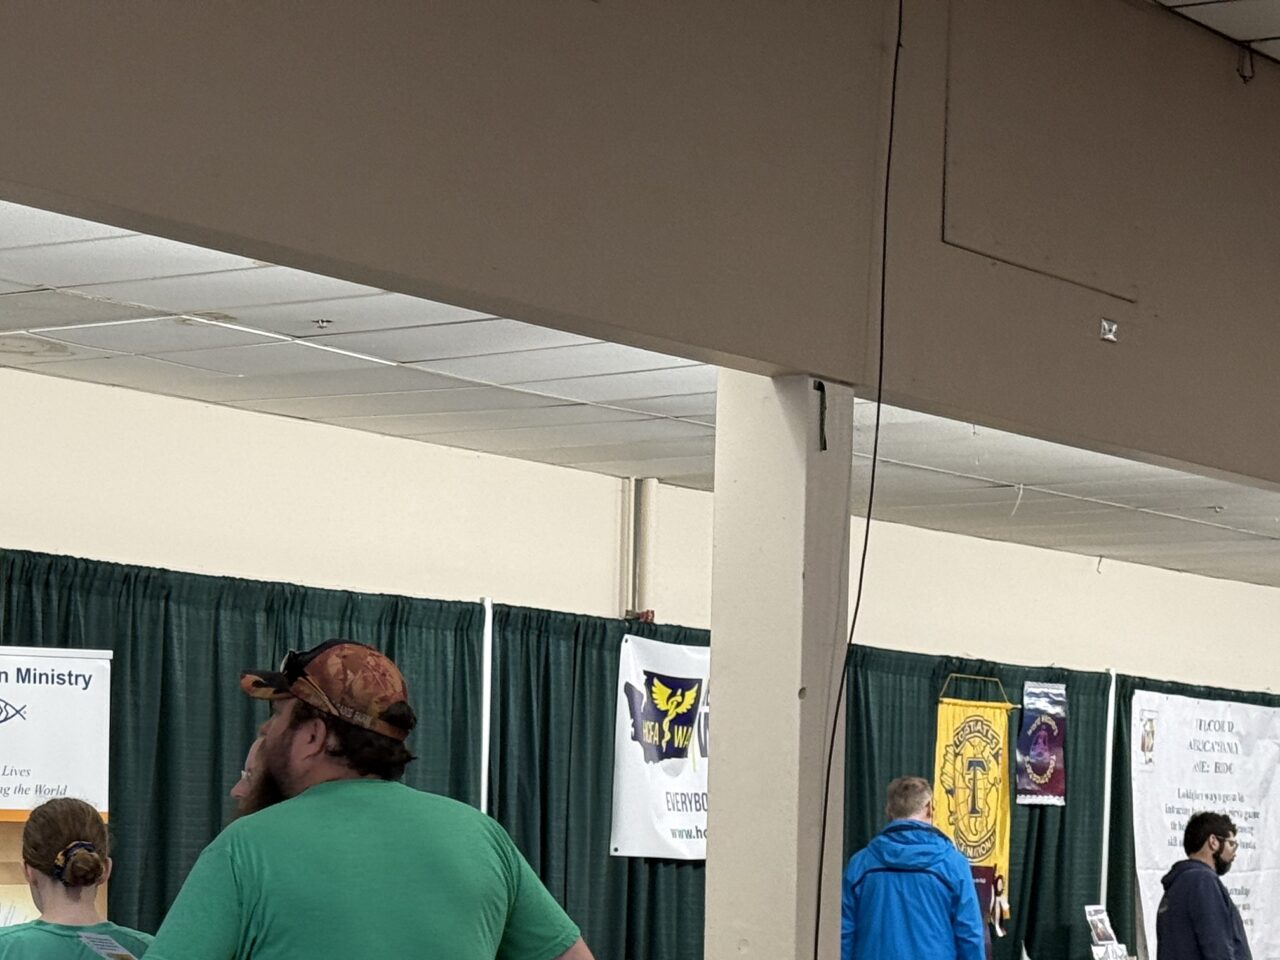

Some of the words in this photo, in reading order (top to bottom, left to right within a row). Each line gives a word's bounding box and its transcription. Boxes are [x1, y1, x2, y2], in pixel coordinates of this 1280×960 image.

[16, 668, 93, 690] Ministry
[2, 763, 32, 777] Lives
[13, 783, 31, 796] the
[34, 784, 68, 797] World
